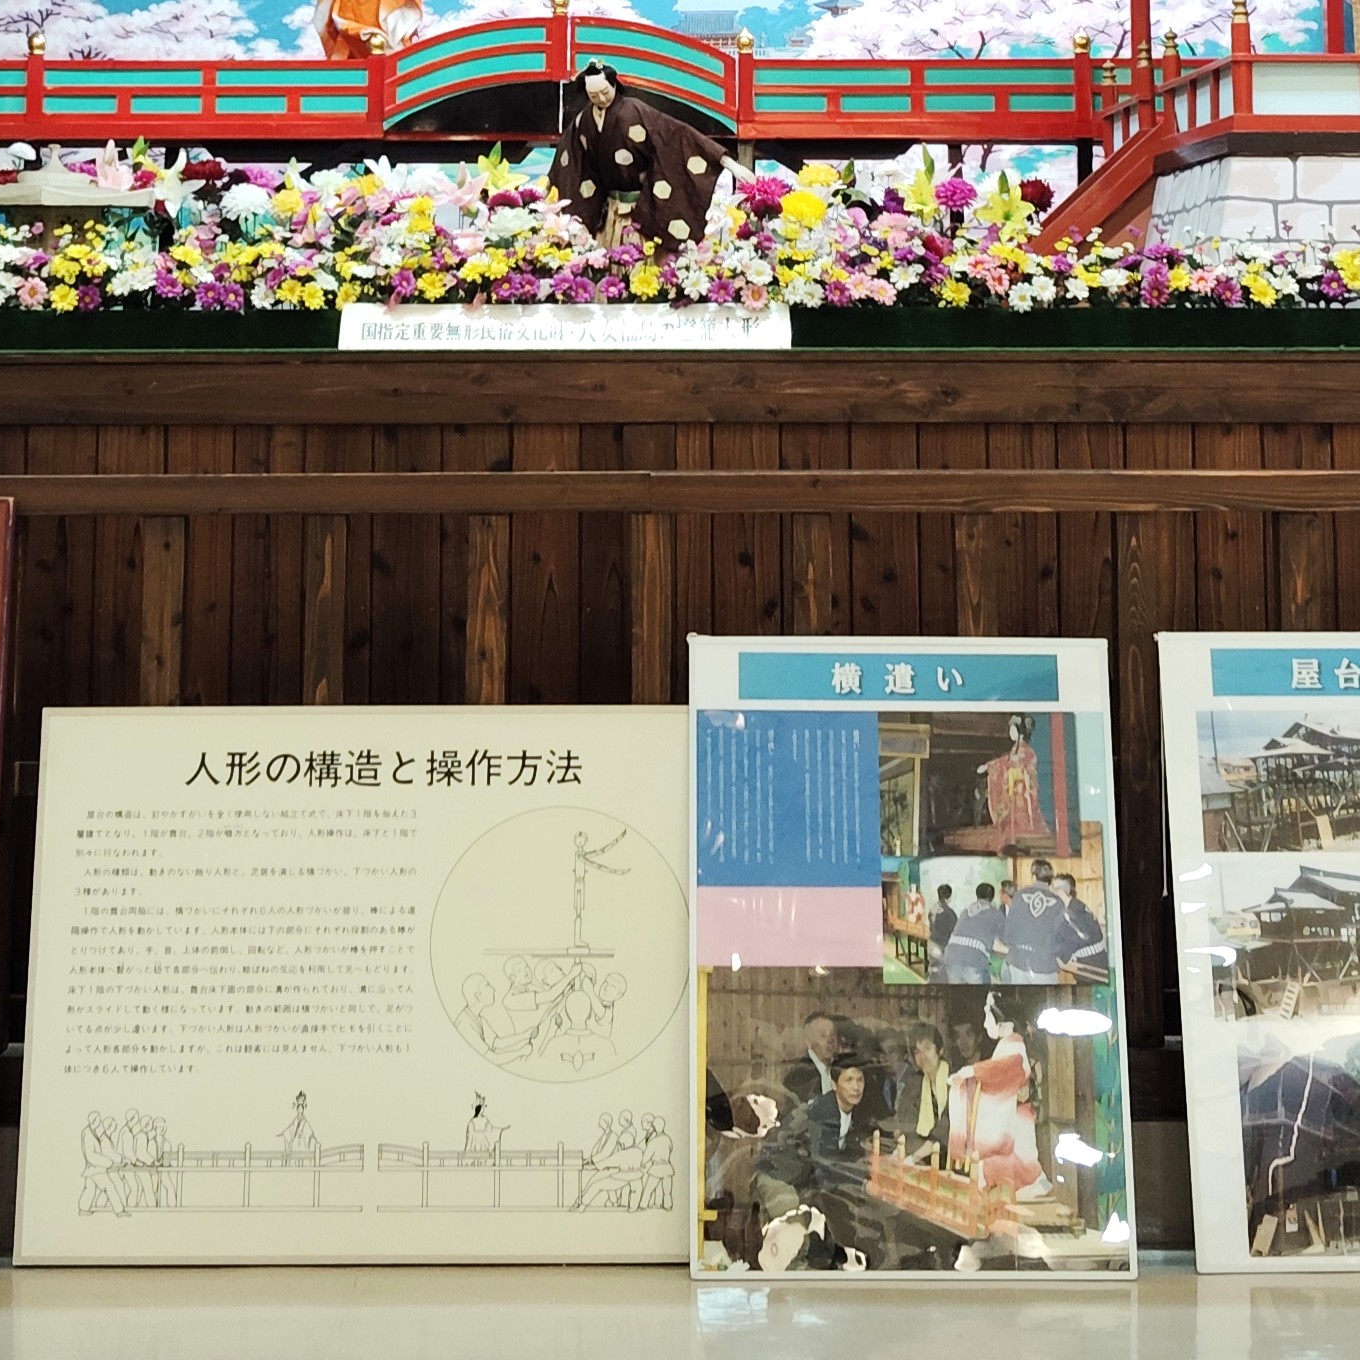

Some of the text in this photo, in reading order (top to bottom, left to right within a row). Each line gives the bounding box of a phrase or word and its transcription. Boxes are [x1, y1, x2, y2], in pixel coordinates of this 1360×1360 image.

[831, 661, 966, 695] 横遣い
[184, 749, 584, 788] 人形の構造と操作方法
